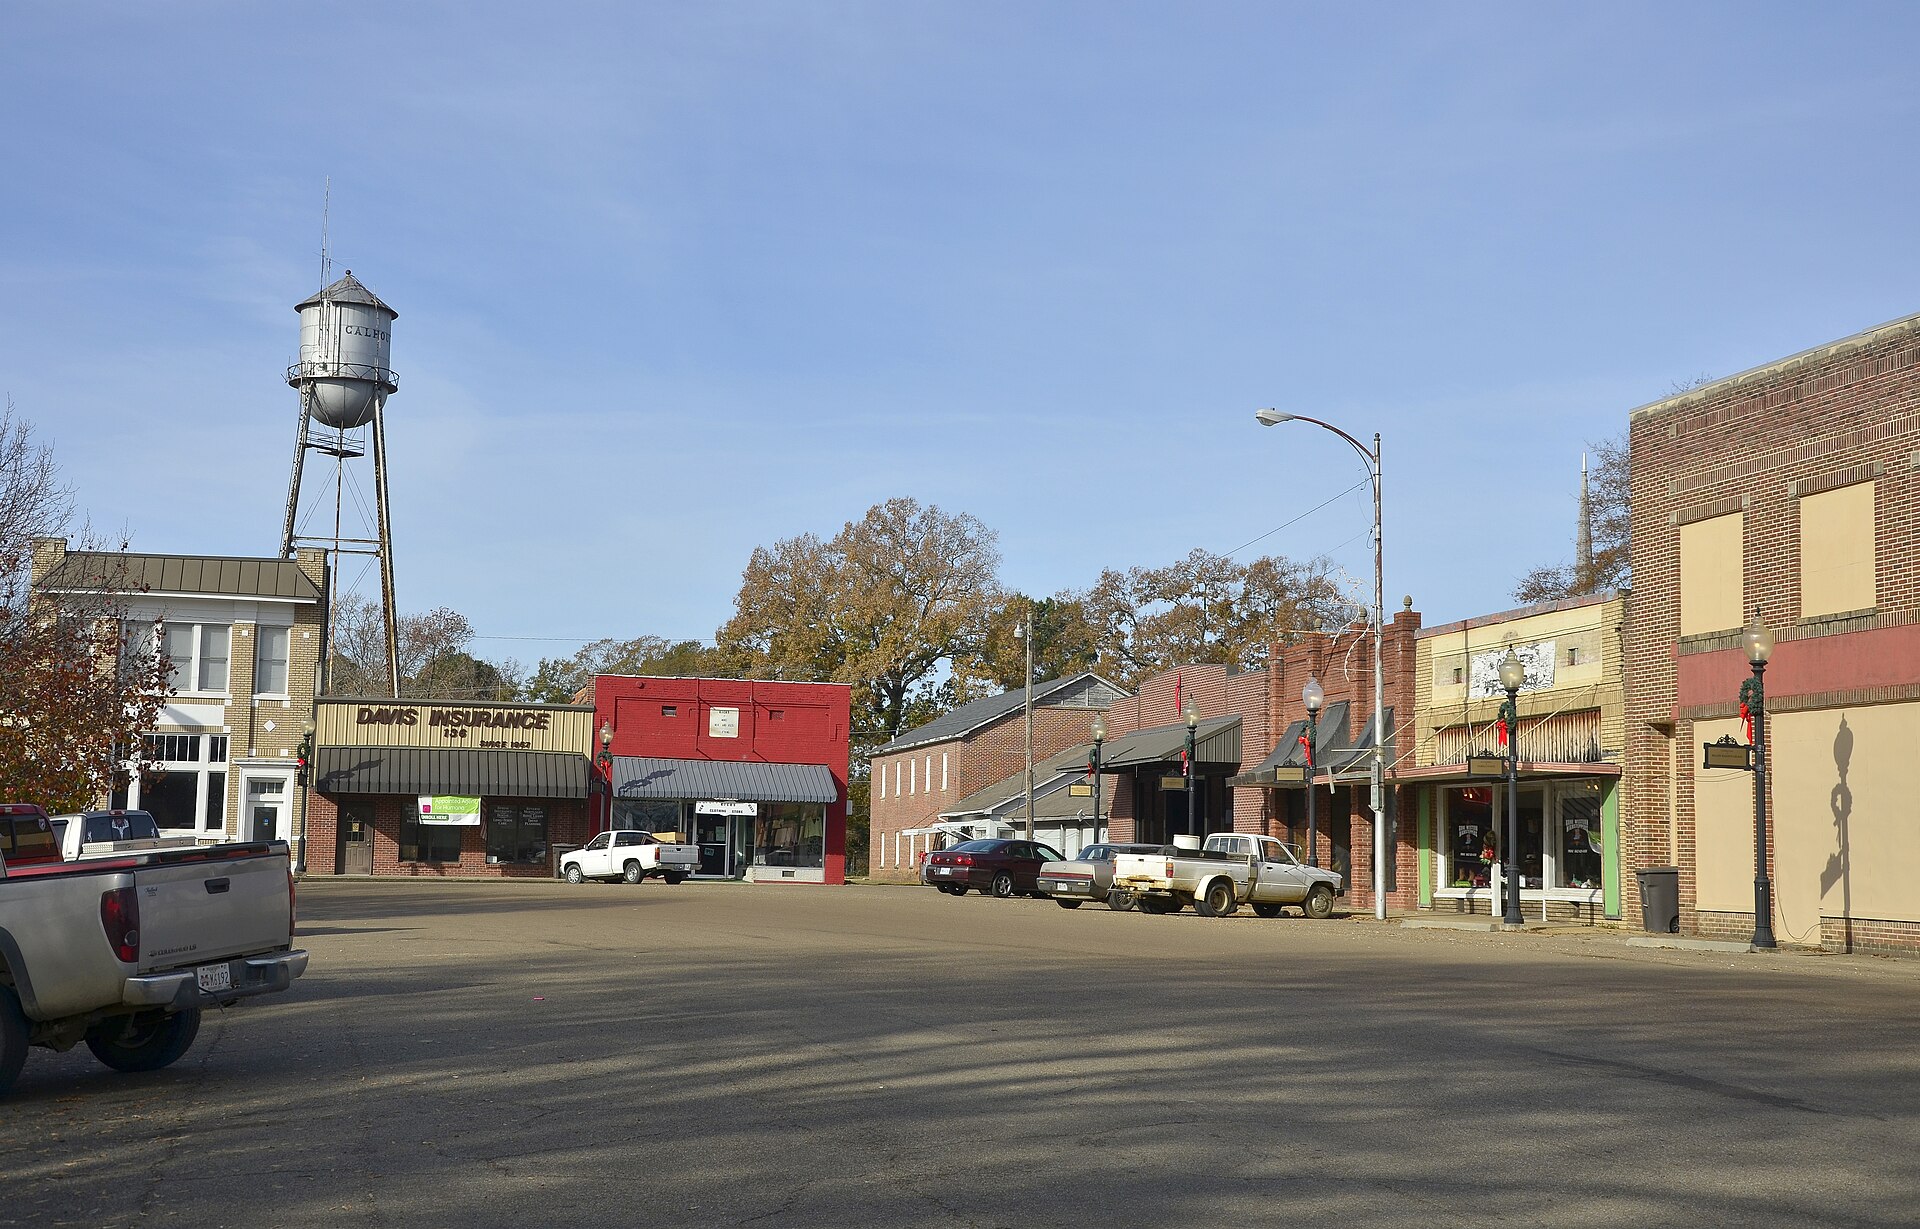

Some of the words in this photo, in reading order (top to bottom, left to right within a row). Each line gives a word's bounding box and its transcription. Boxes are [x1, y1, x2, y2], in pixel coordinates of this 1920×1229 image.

[356, 708, 418, 725] DAVIS
[429, 710, 551, 730] INSURANCE
[444, 729, 467, 738] 136
